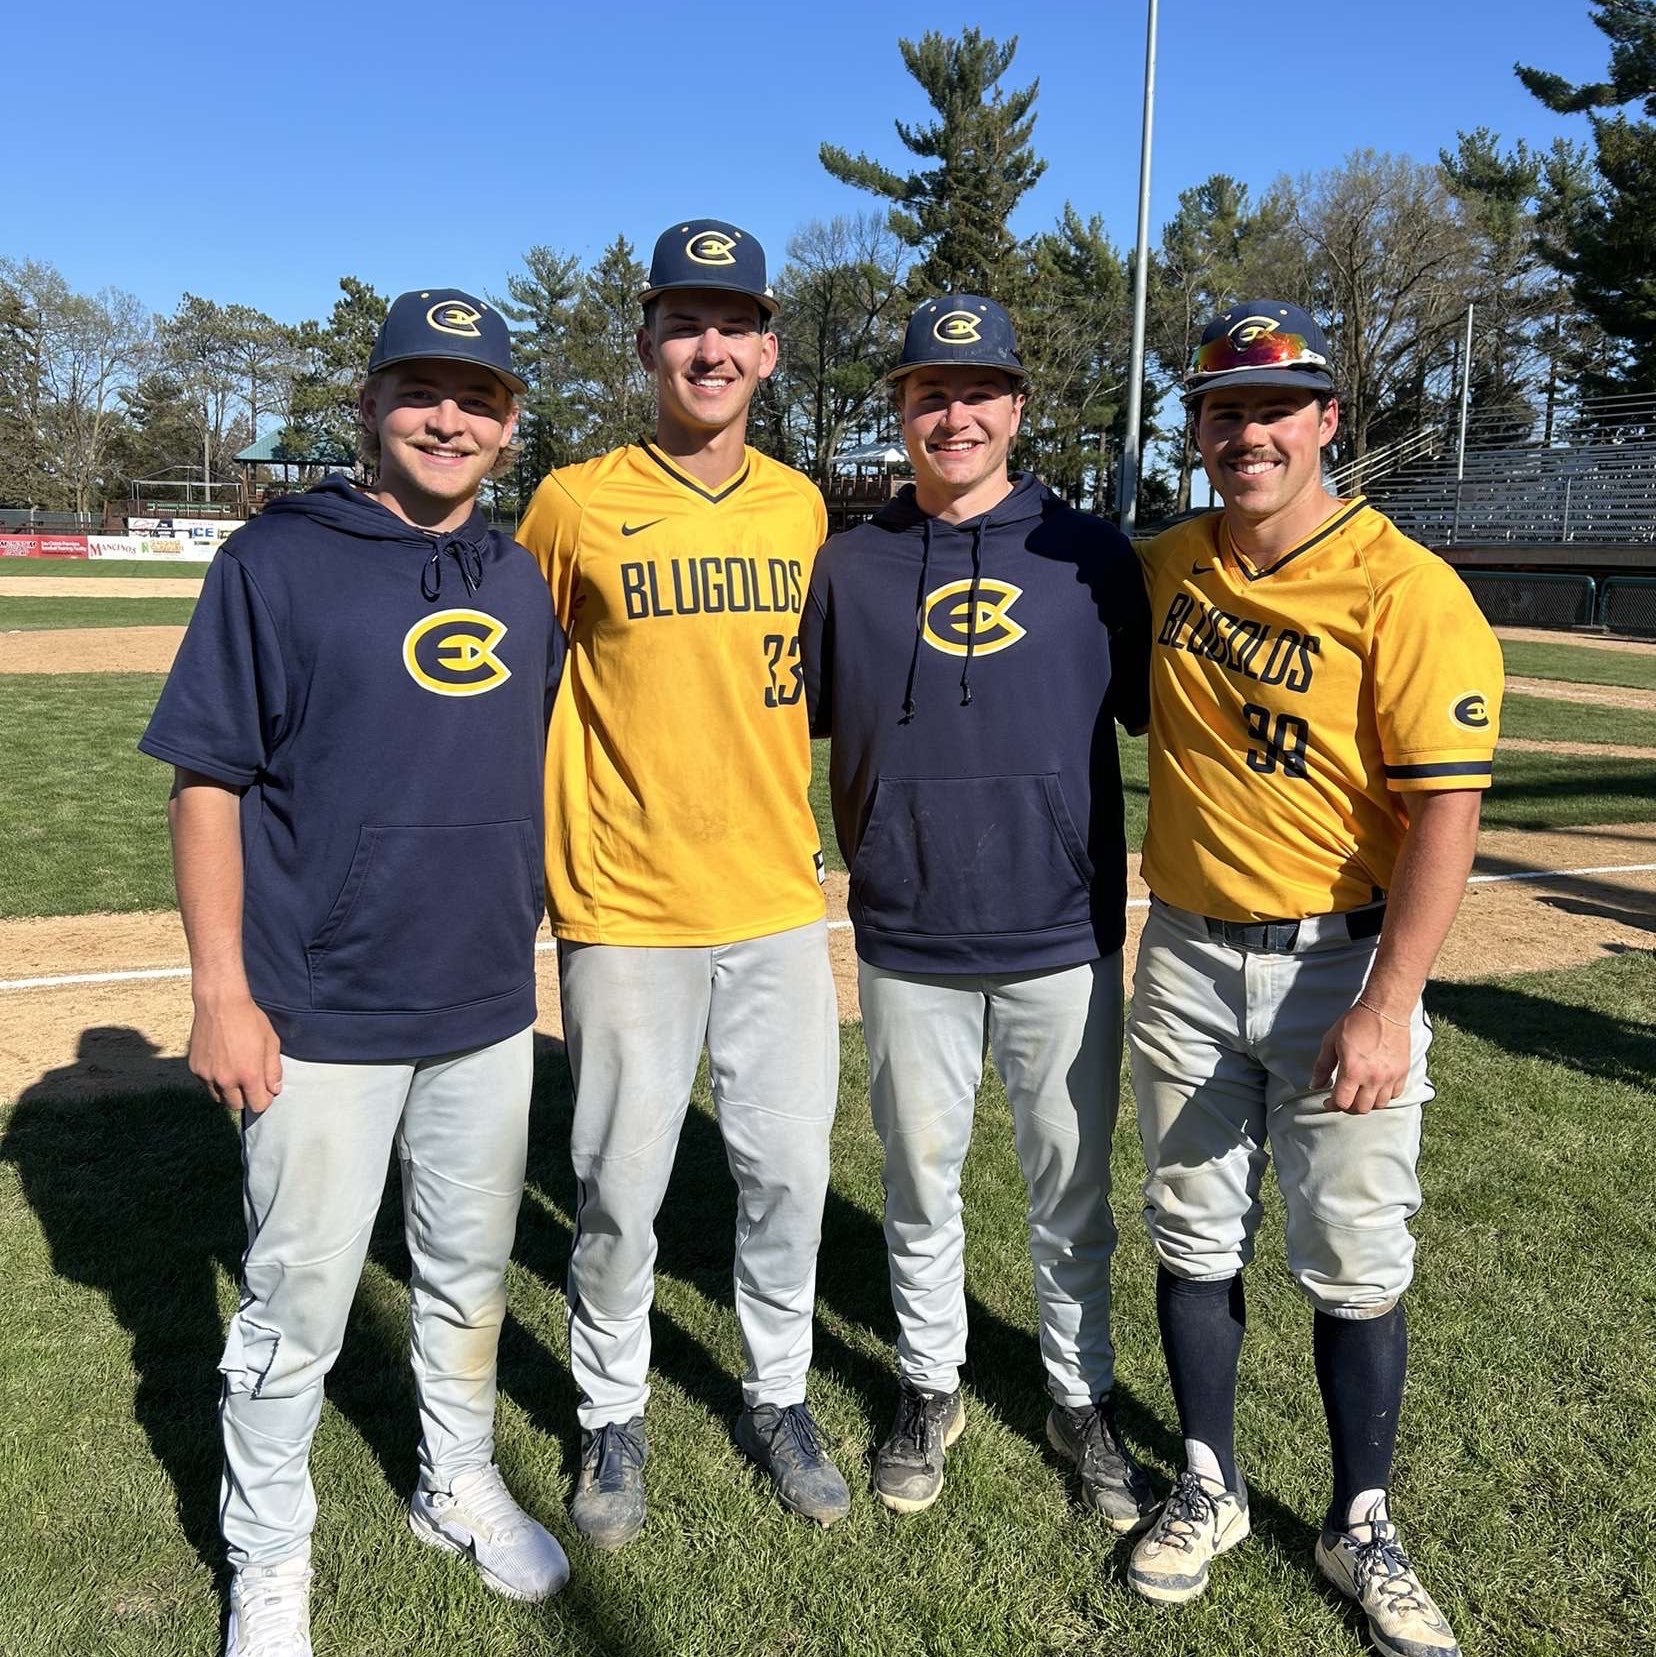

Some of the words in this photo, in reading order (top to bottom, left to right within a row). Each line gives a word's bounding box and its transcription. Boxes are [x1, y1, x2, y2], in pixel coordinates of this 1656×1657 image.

[620, 556, 802, 620] BLUGOLDS
[763, 634, 804, 708] 33
[1157, 592, 1321, 694] BLUGOLDS
